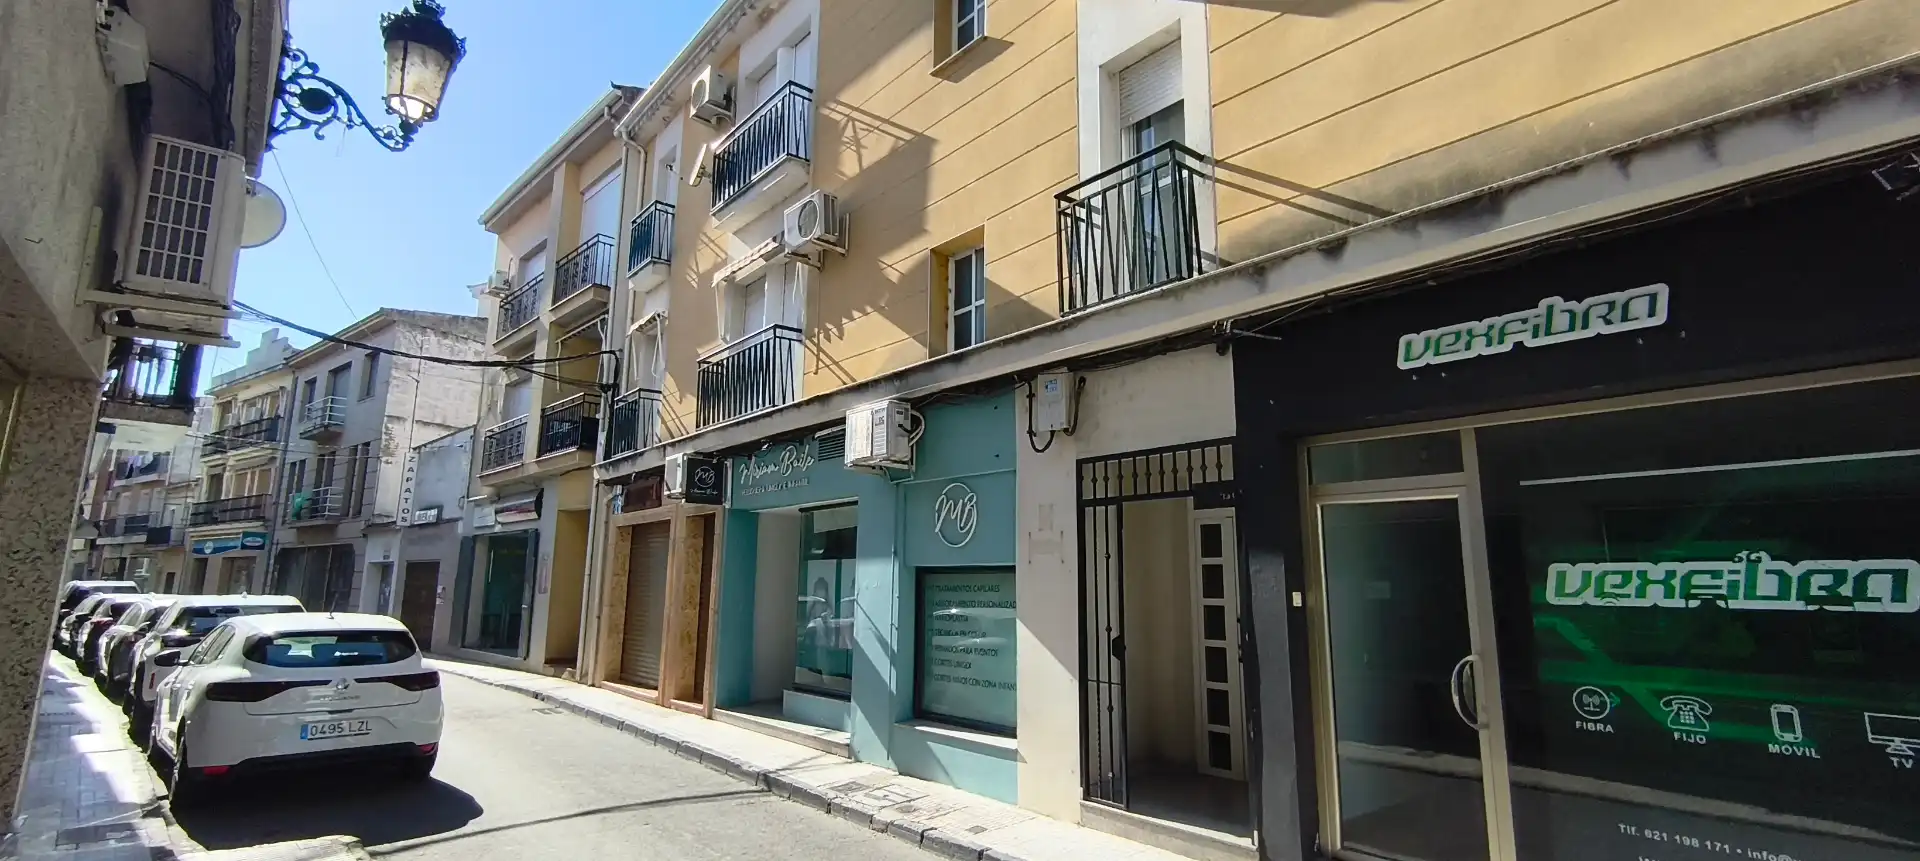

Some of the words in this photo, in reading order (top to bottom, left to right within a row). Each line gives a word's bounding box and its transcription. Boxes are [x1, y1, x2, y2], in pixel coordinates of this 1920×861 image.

[400, 456, 416, 523] ZAPATOS
[935, 492, 976, 533] MB
[973, 584, 1001, 593] CAPILARES
[310, 723, 344, 737] 0495
[348, 720, 372, 733] LZL
[1575, 720, 1614, 733] FIBRA
[1674, 731, 1706, 745] FIJO
[1890, 756, 1914, 769] TV
[1675, 834, 1700, 848] 198
[1705, 840, 1731, 854] 171
